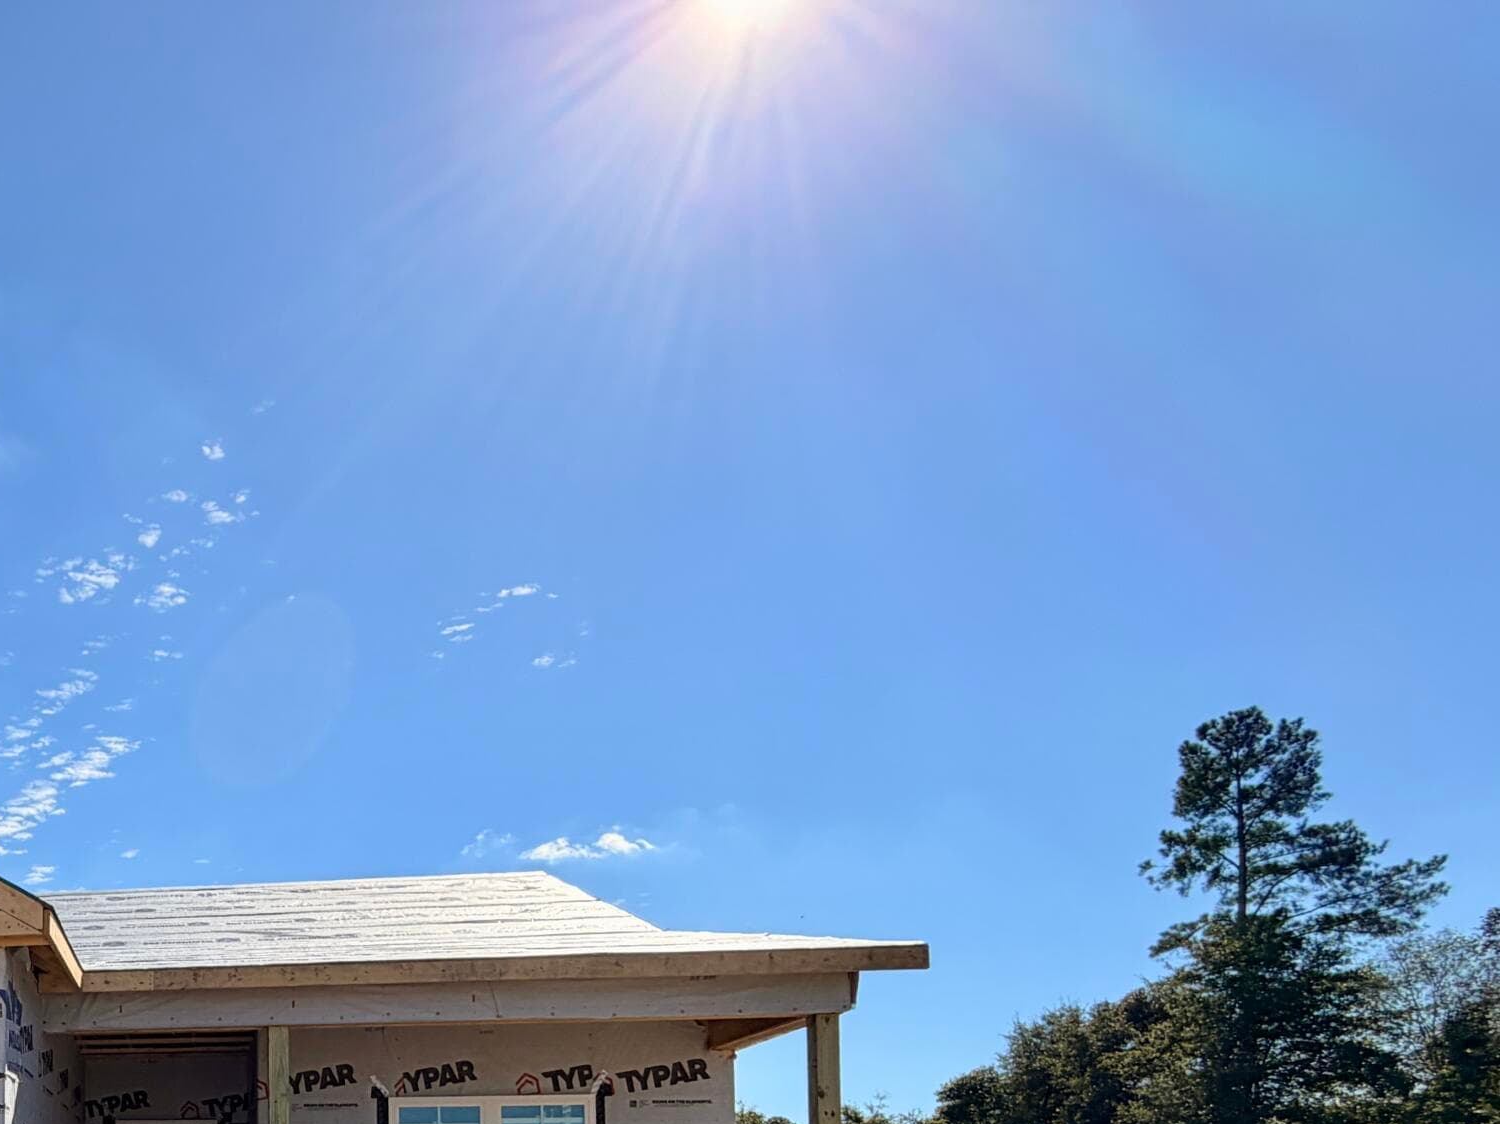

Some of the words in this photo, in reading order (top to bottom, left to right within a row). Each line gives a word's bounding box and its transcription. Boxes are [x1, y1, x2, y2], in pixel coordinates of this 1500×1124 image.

[289, 1064, 357, 1094] YPAR
[403, 1060, 477, 1092] YPAR
[542, 1064, 592, 1092] TYP
[615, 1058, 710, 1092] TYPAR
[84, 1090, 150, 1118] TYPAR
[202, 1094, 250, 1118] TYP
